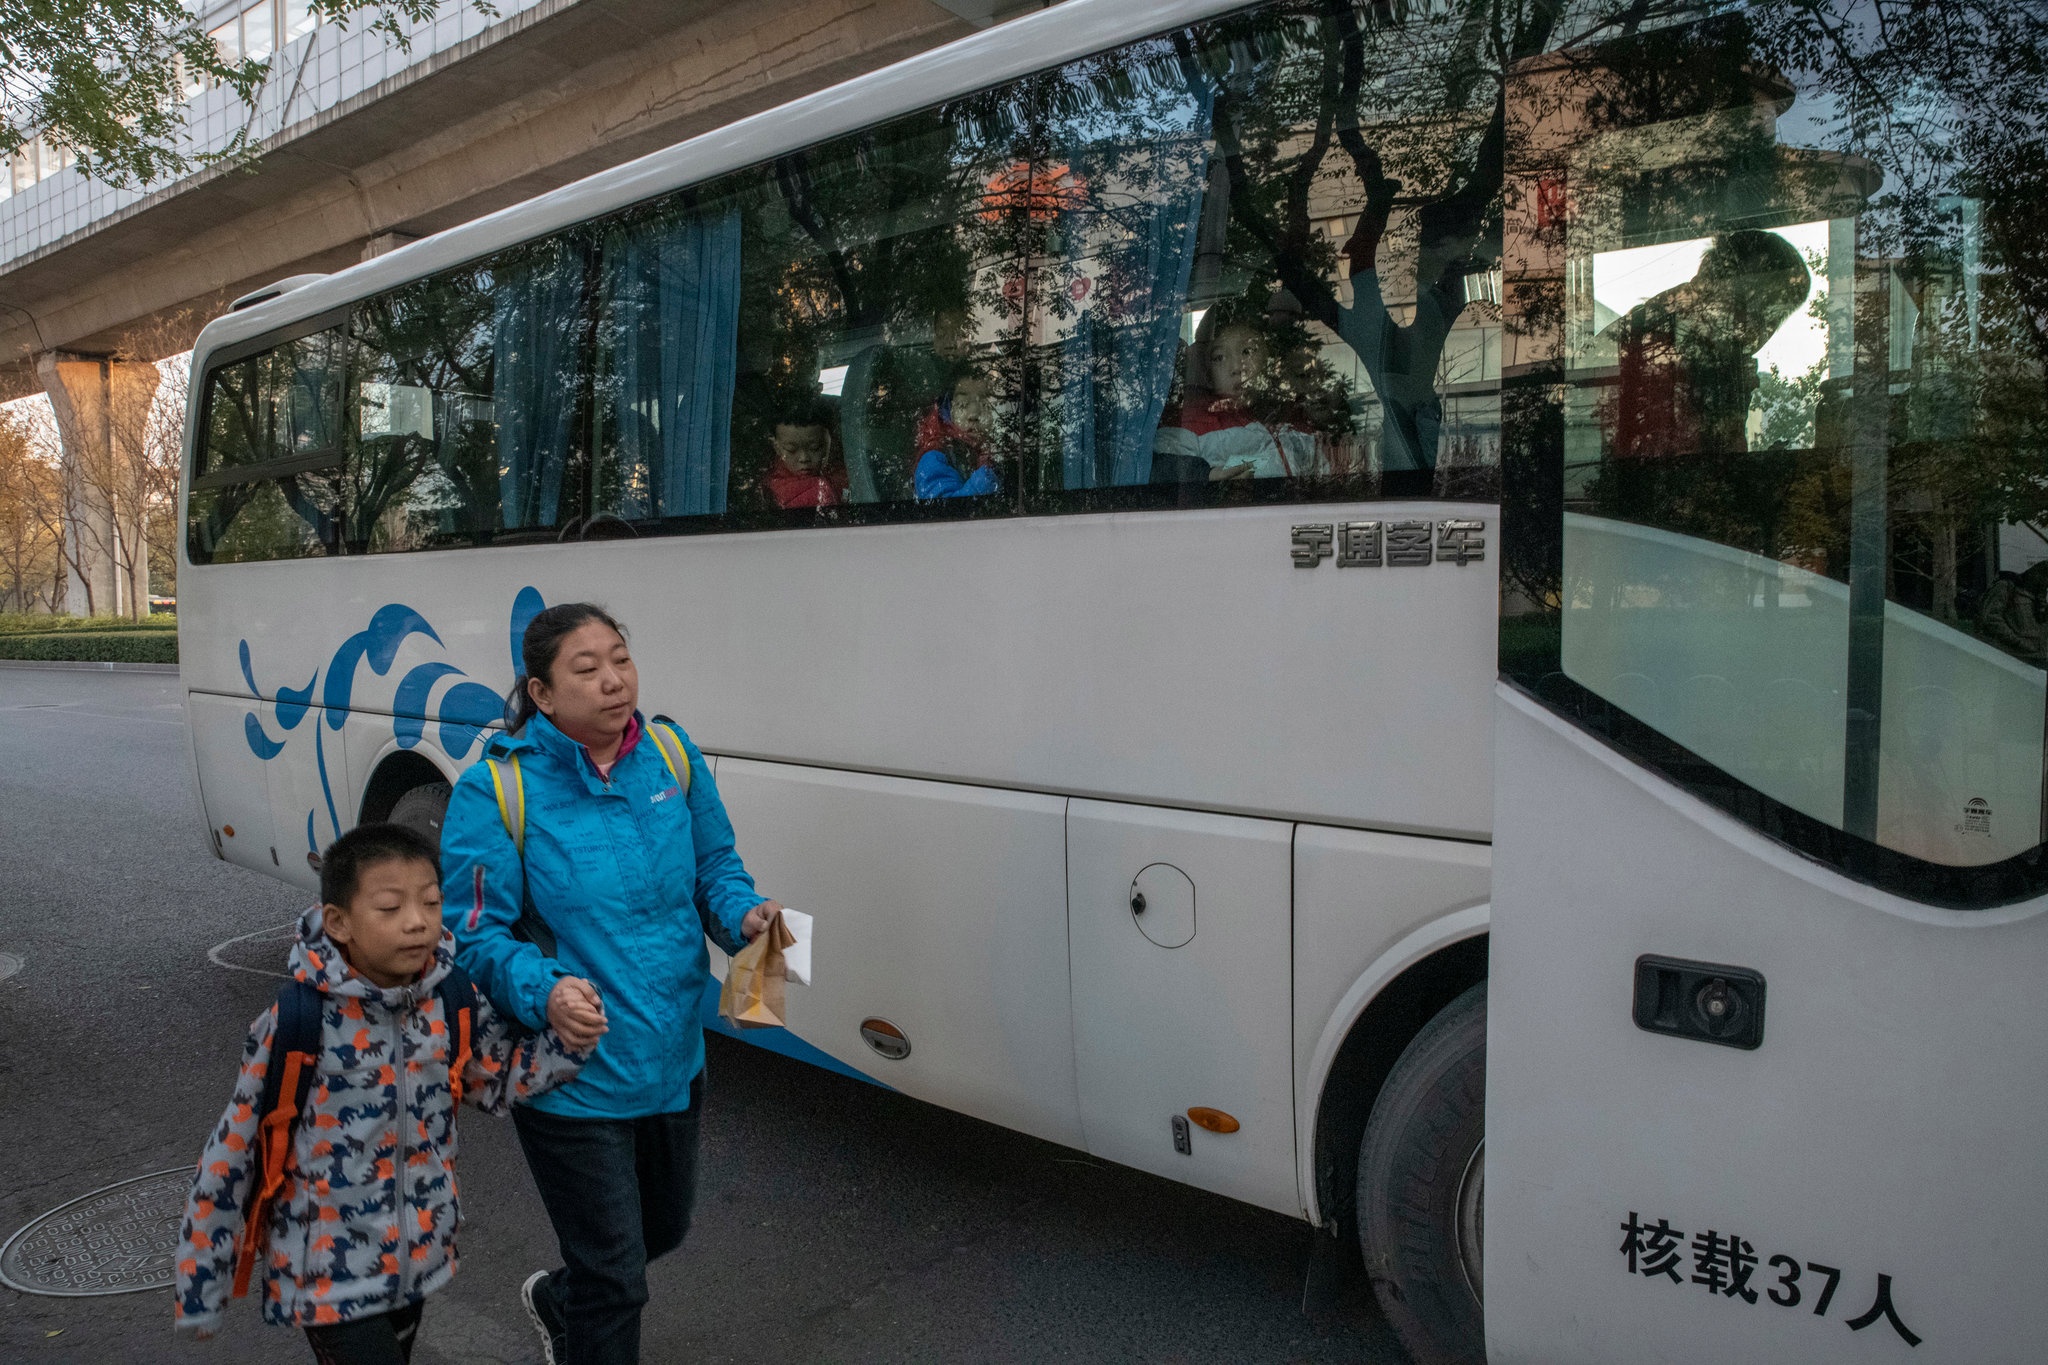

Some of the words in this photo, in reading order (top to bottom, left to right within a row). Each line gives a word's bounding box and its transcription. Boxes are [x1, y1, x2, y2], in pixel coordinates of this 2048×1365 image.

[1290, 518, 1485, 569] 宇通客车
[1619, 1211, 1923, 1348] 核载37人
